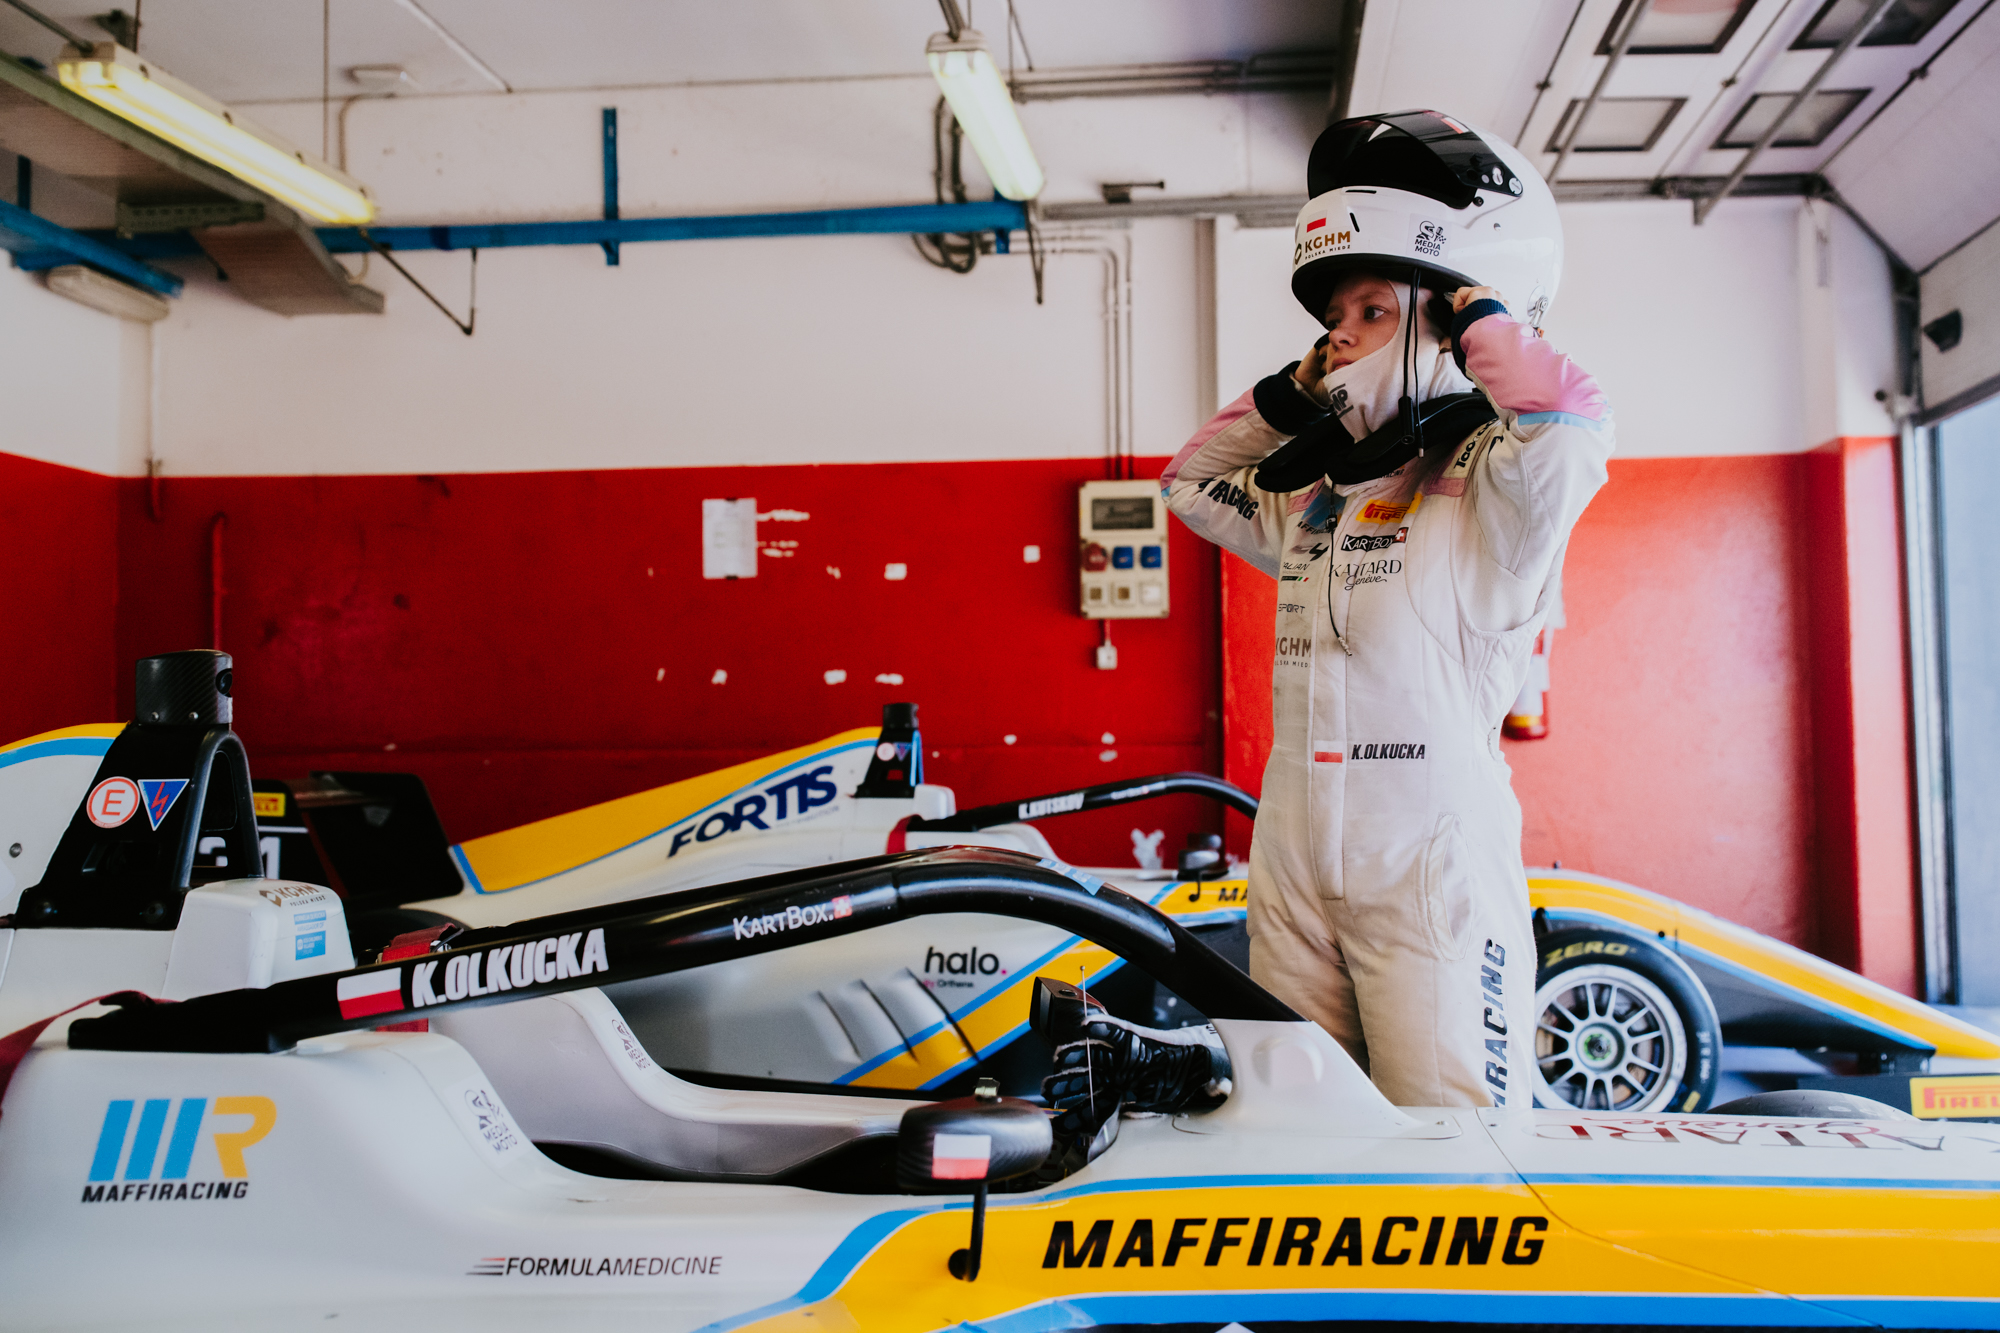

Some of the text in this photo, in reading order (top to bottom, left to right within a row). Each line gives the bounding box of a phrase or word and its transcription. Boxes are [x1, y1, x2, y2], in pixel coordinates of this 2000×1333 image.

[1304, 231, 1351, 254] KGHM
[1414, 238, 1441, 251] MEDIA
[1414, 245, 1441, 257] MOTO
[1305, 250, 1326, 260] POLSKA
[1283, 562, 1311, 571] ALIAN
[1344, 574, 1388, 591] Genève
[1351, 743, 1426, 760] K.OLKUCKA
[101, 788, 126, 816] E
[667, 765, 838, 860] FORTIS
[924, 945, 1008, 976] halo.
[1545, 940, 1630, 968] ZERO
[412, 927, 610, 1009] K.OLKUCKA
[482, 1121, 510, 1144] MEDIA
[492, 1134, 518, 1155] MOTO
[81, 1181, 249, 1204] MAFFIRACING
[1041, 1215, 1549, 1270] MAFFIRACING
[505, 1256, 723, 1277] FORMULAMEDICINE
